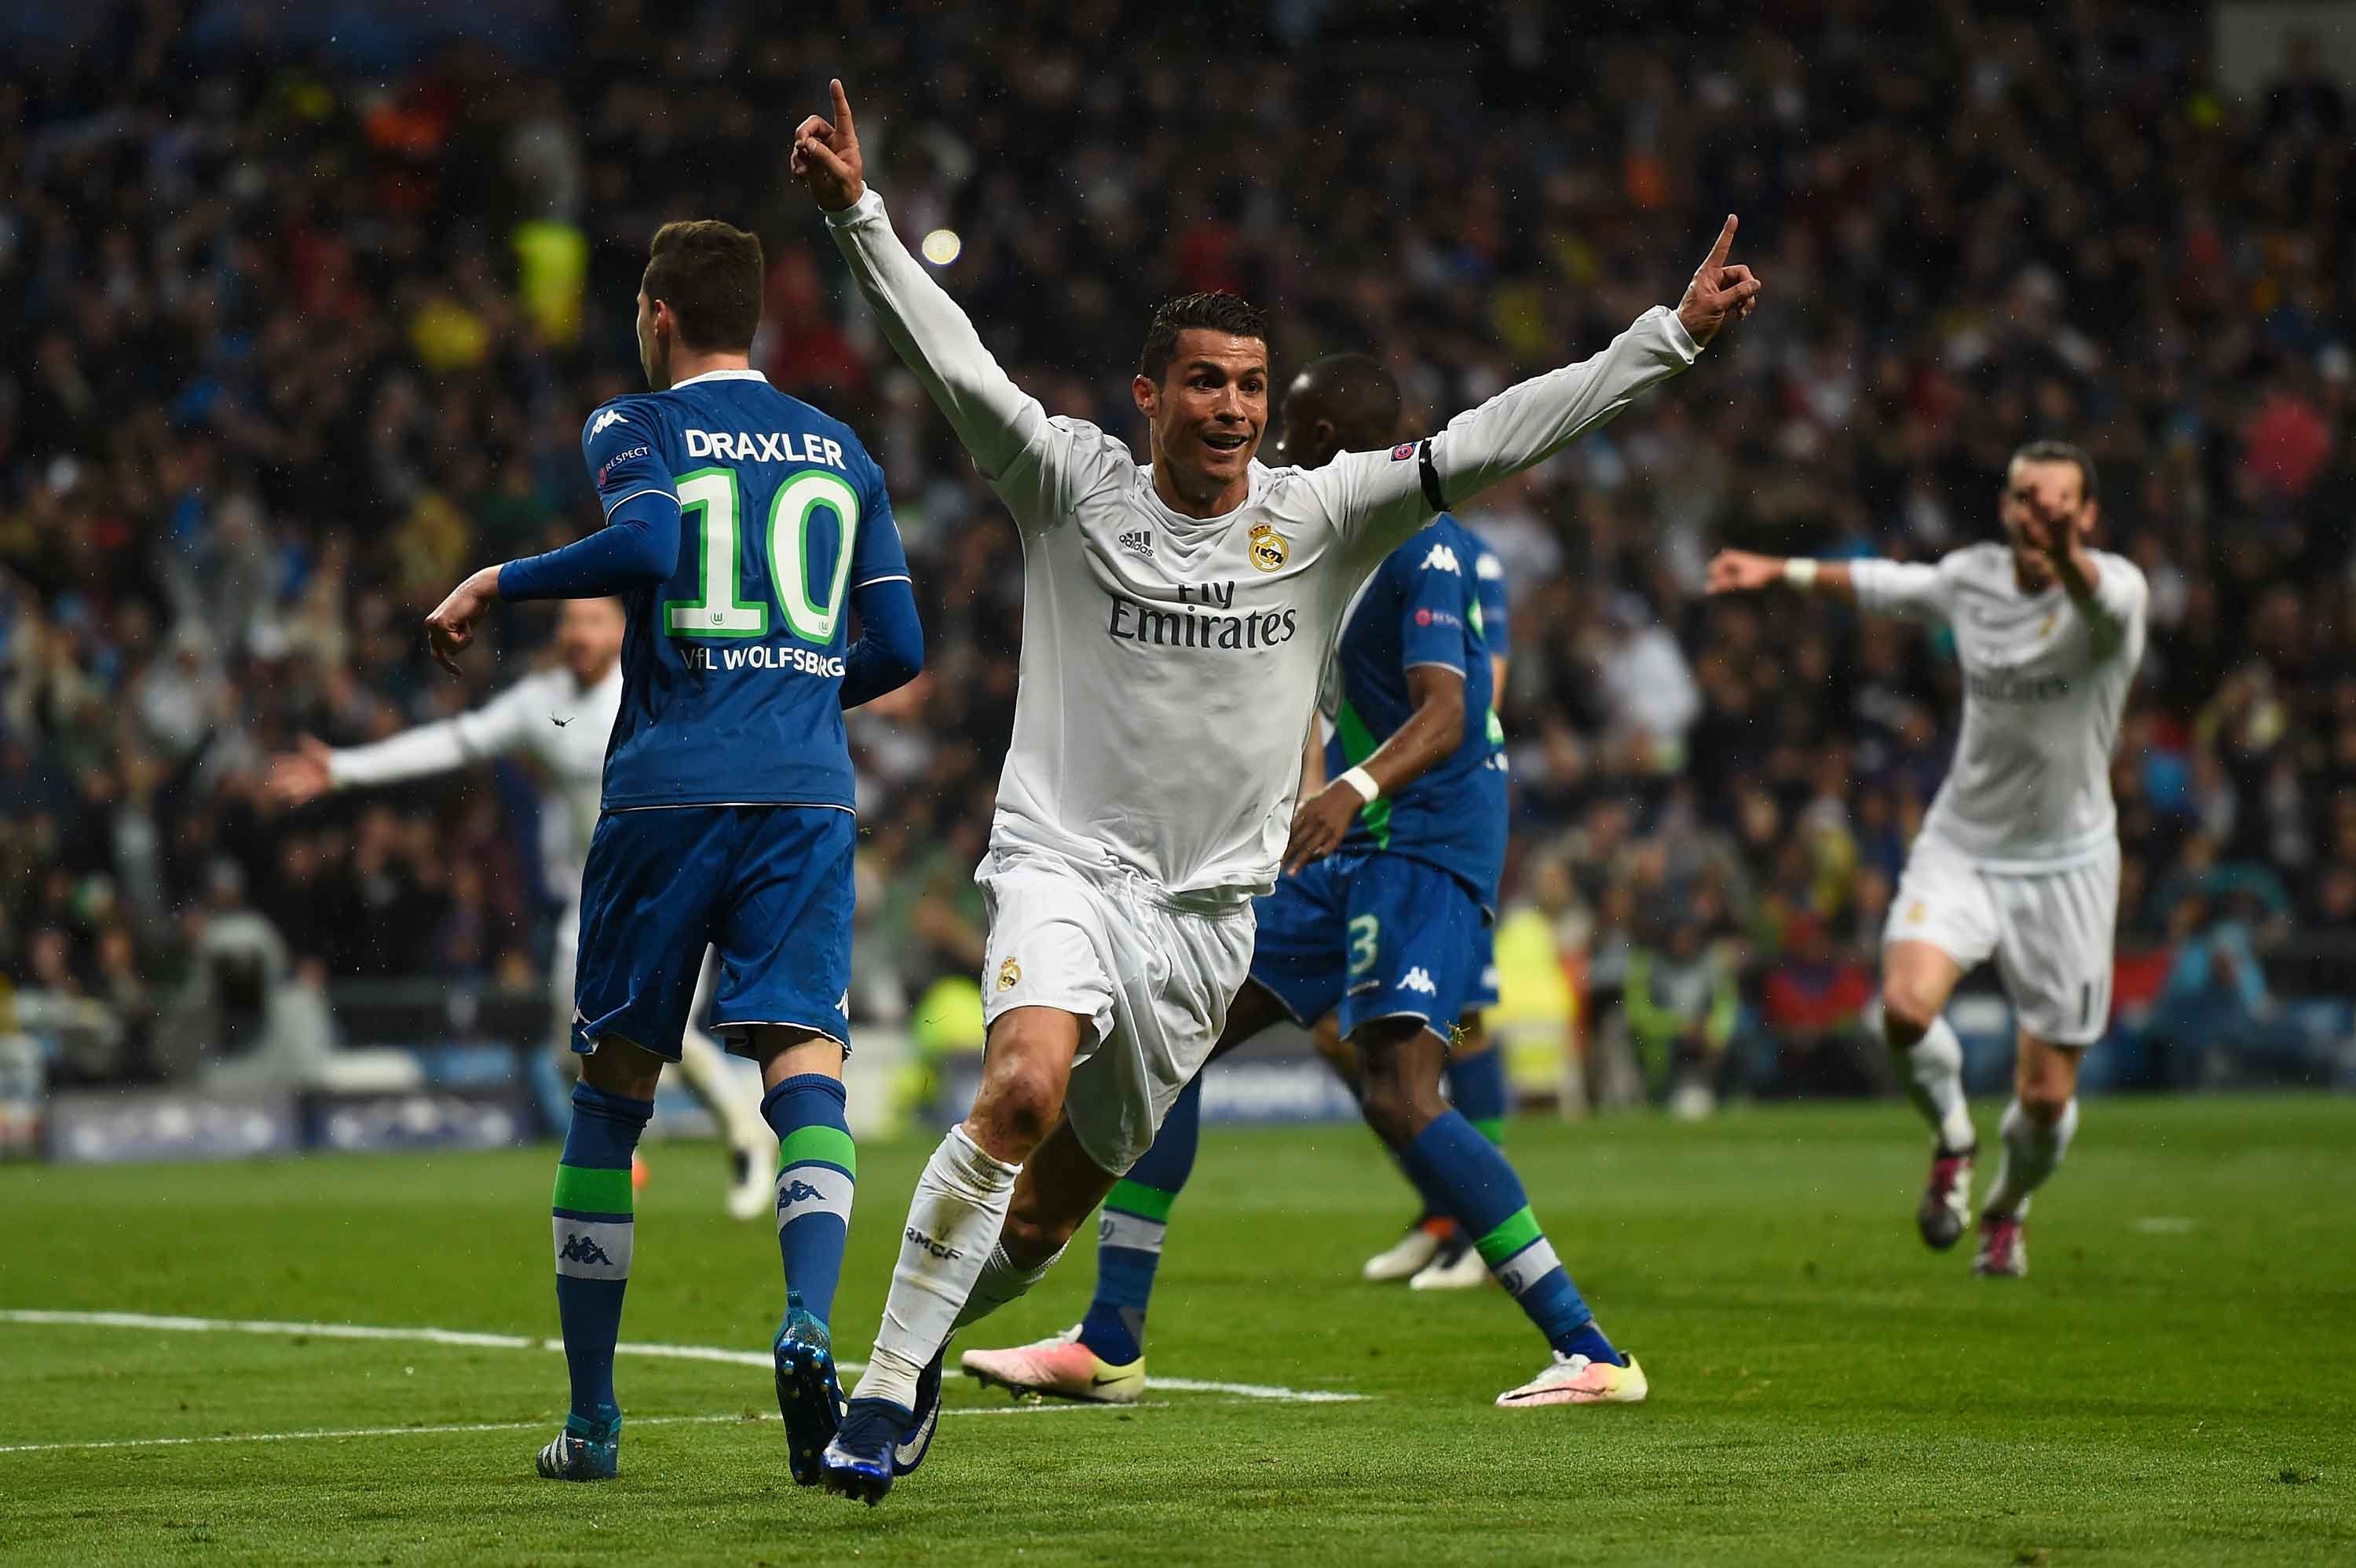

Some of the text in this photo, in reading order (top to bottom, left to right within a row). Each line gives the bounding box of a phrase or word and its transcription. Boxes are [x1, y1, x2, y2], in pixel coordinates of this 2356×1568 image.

[605, 447, 648, 471] RESPECT
[685, 429, 847, 470] DRAXLER
[664, 467, 861, 645] 10
[1118, 534, 1154, 557] adidas
[1110, 596, 1297, 649] Emirates
[681, 648, 718, 670] VfL
[906, 1226, 963, 1259] RMCF
